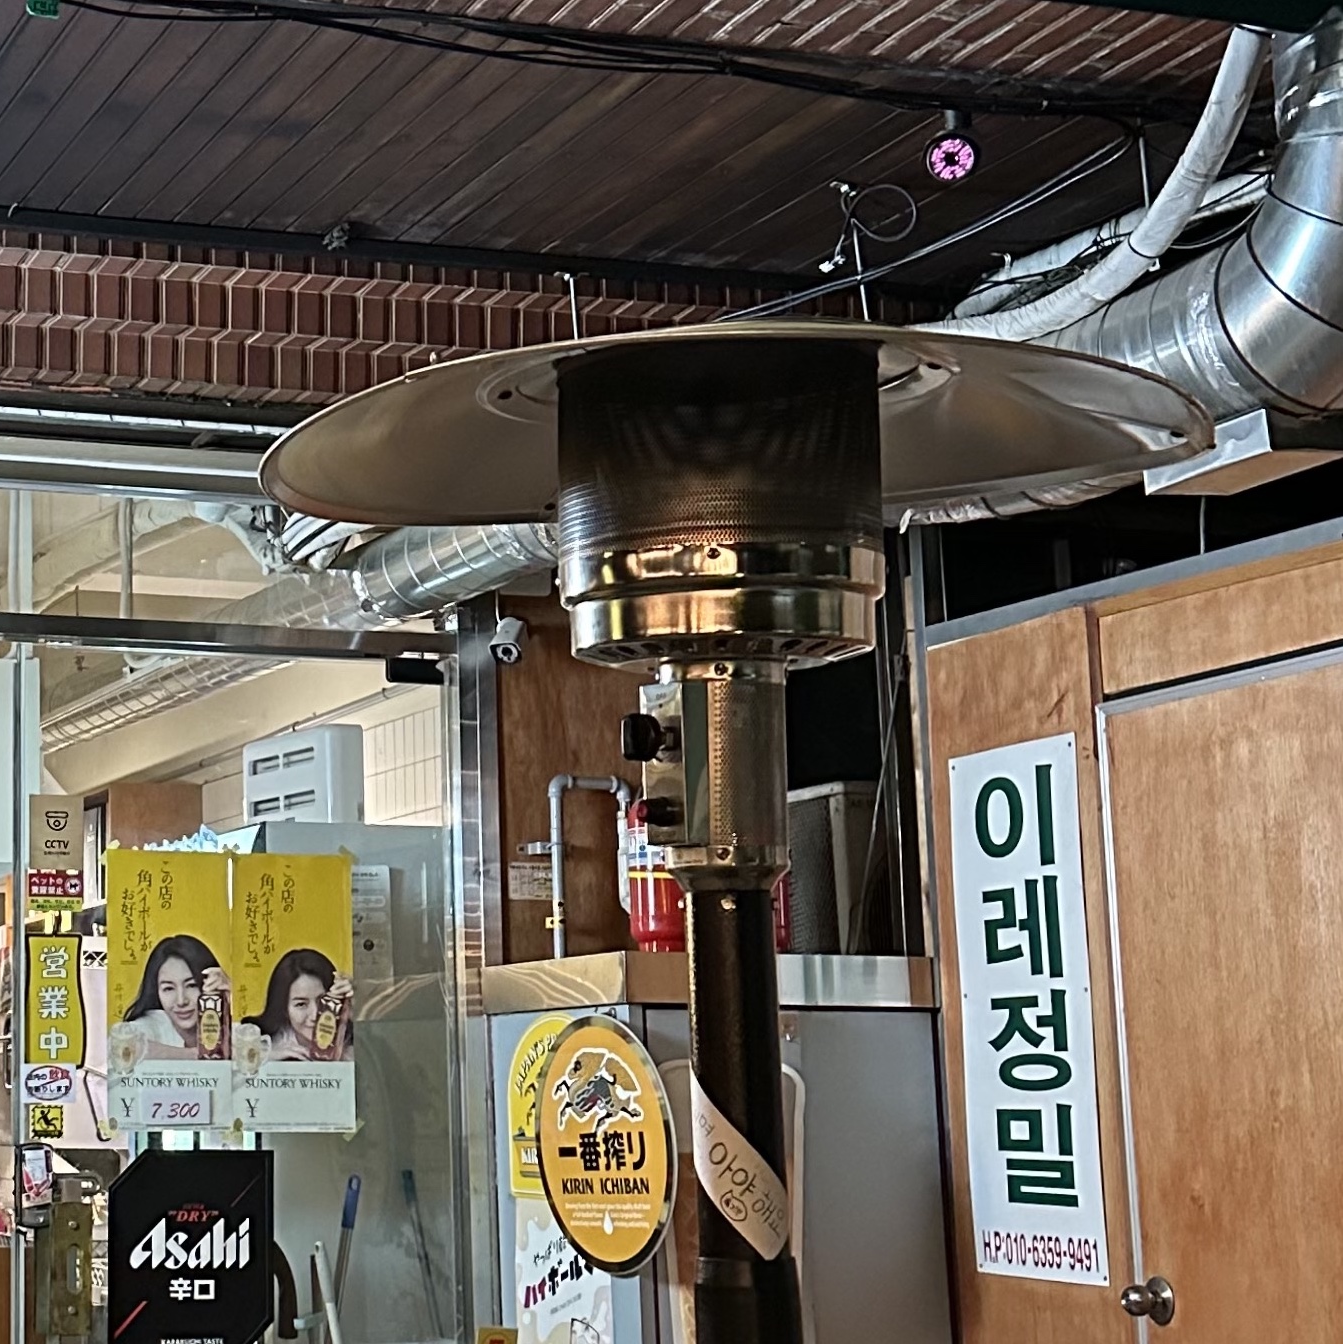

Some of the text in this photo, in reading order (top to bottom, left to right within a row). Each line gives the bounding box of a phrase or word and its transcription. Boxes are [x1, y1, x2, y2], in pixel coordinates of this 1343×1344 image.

[44, 840, 69, 849] CCTV
[159, 860, 173, 911] この店の
[281, 864, 295, 914] この店の
[136, 868, 153, 953] 角ハイボールが
[259, 872, 275, 955] 角ハイボールが
[38, 946, 71, 1060] 営業中
[974, 764, 1079, 1208] 이레정밀
[120, 1077, 219, 1088] SUNTORY WHISKY
[245, 1077, 342, 1089] SUNTORY WHISKY
[521, 1147, 539, 1165] KIR
[558, 1131, 646, 1171] 一番搾り
[562, 1177, 650, 1195] KIRIN ICHIBAN
[129, 1217, 250, 1270] Asahi
[169, 1277, 215, 1300] 辛口
